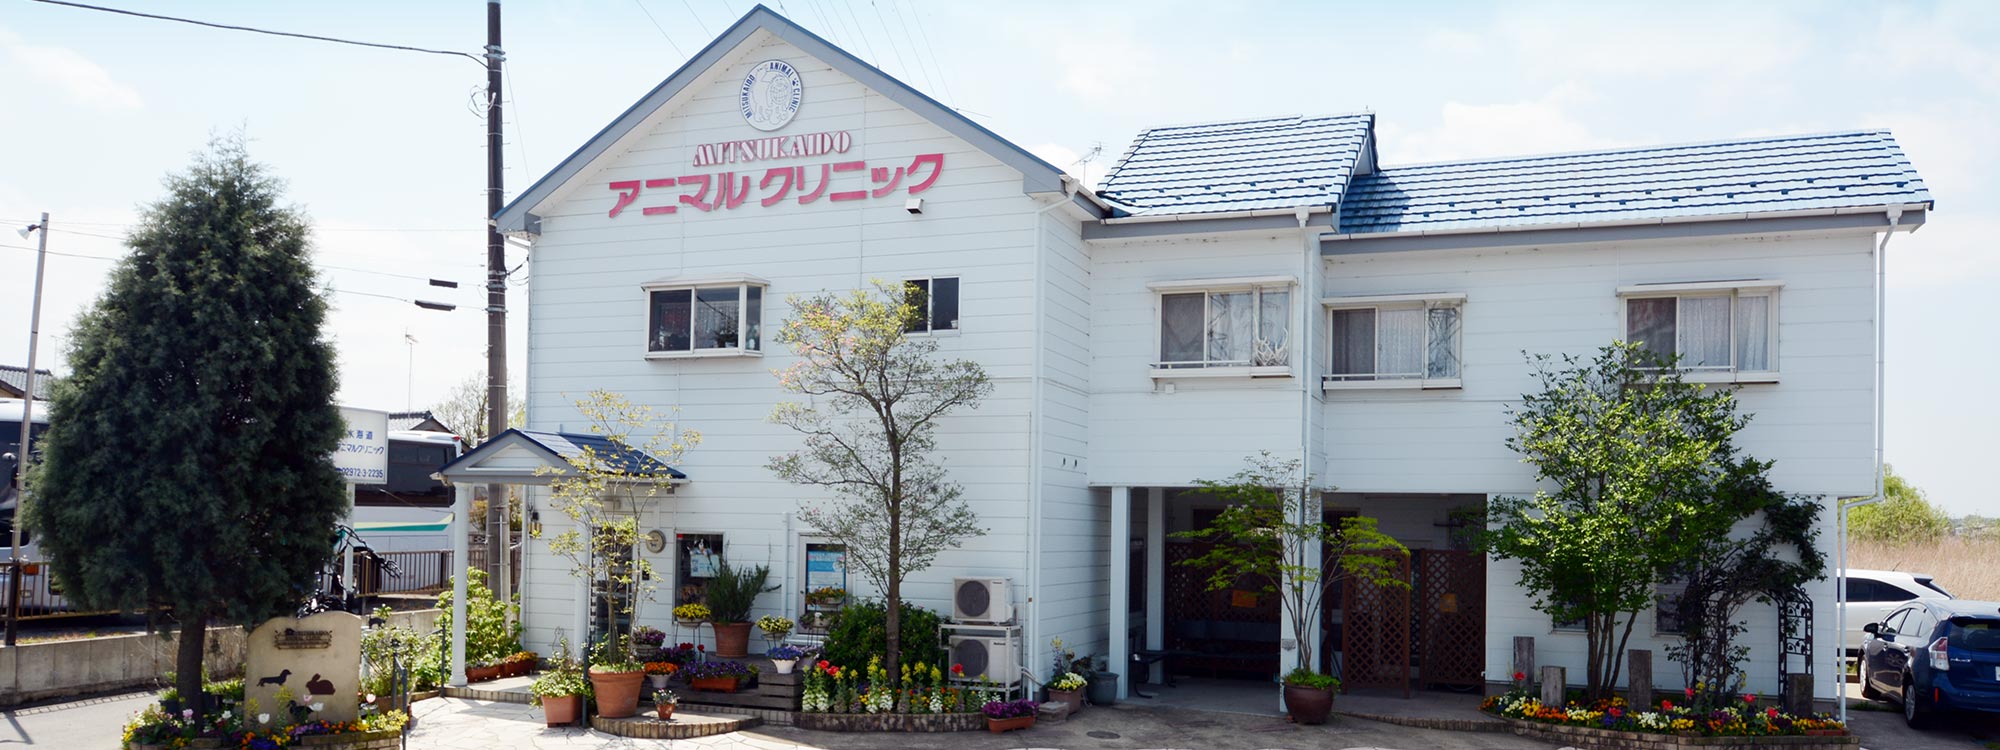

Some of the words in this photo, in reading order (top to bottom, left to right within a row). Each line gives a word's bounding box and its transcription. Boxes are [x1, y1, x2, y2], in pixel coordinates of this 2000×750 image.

[770, 62, 794, 78] ANIMAL
[789, 87, 800, 113] CLINIC
[692, 131, 851, 167] MITSUKAIDO
